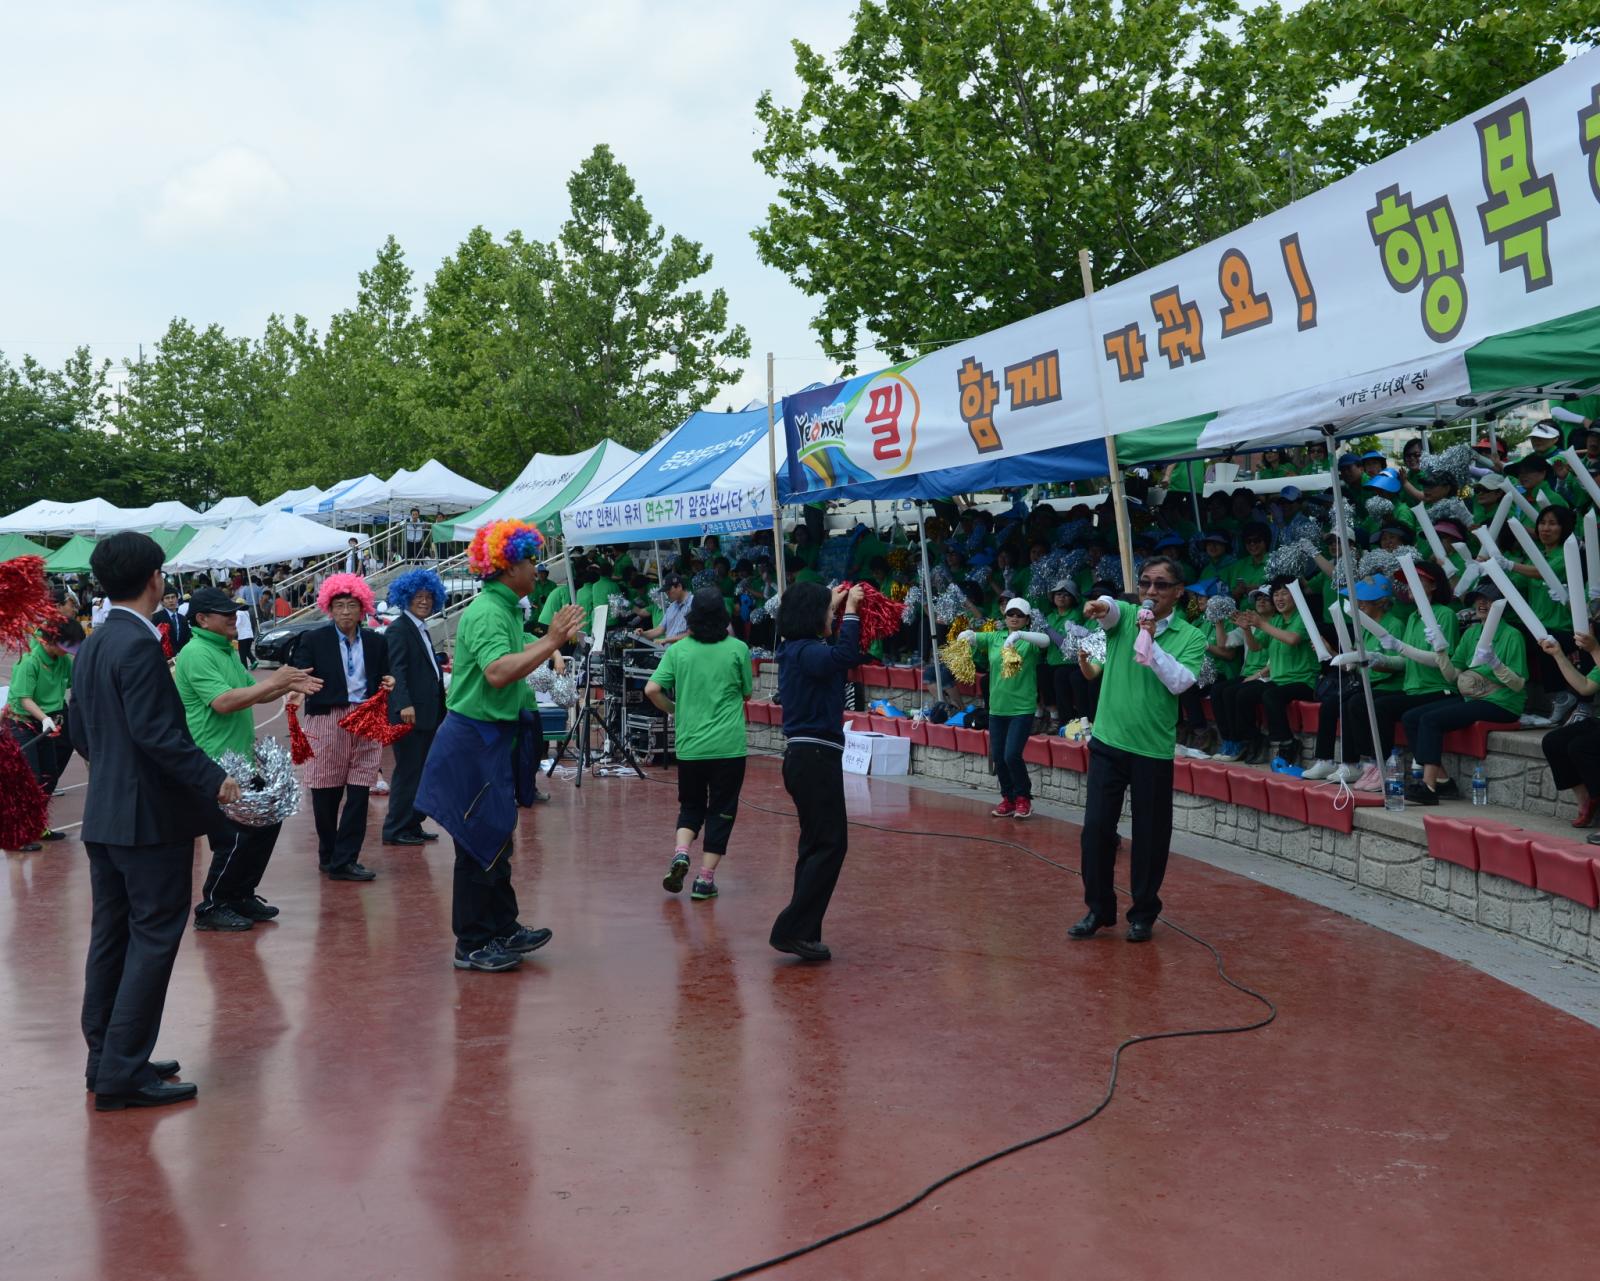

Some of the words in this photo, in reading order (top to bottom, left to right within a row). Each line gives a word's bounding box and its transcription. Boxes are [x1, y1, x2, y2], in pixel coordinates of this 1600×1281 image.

[956, 349, 1062, 454] 함께
[1104, 232, 1318, 382] 가꿔요!
[1366, 83, 1600, 344] 행복
[795, 415, 844, 452] Yeonsu
[575, 510, 594, 529] GCF
[596, 504, 621, 527] 인천시
[624, 502, 642, 526] 유치
[645, 496, 684, 522] 연수구가
[688, 488, 742, 518] 앞장섭니다
